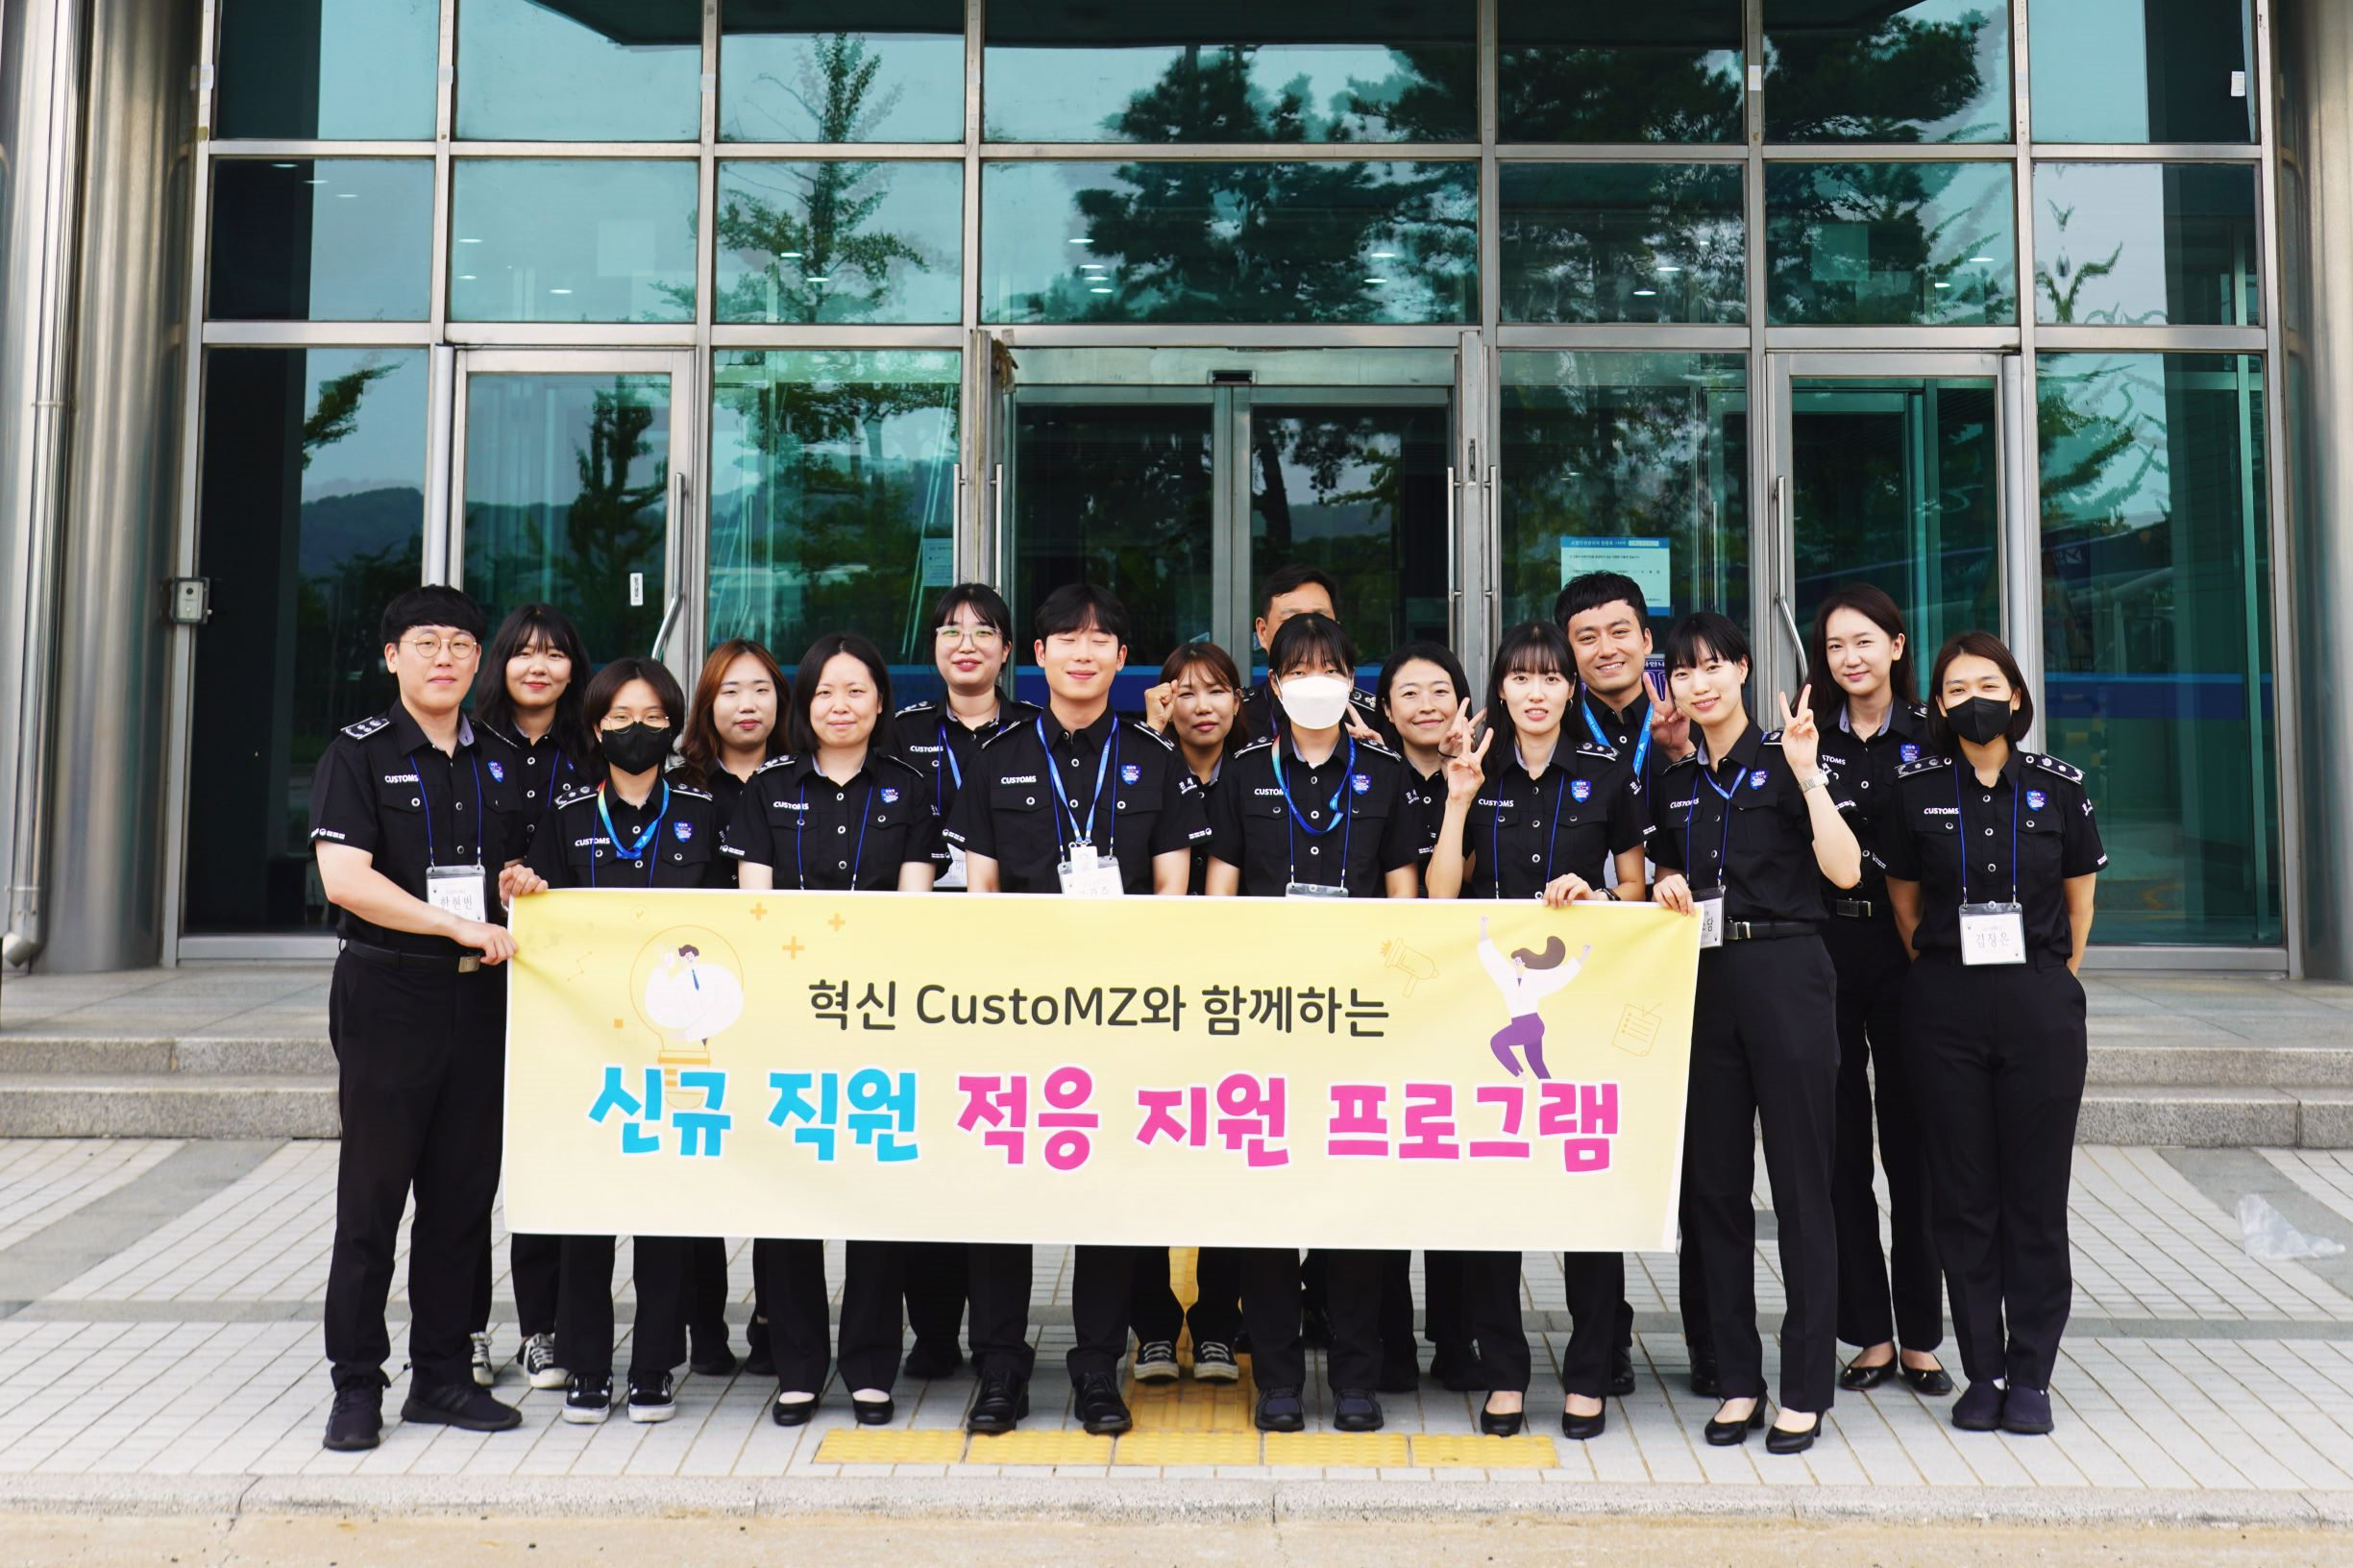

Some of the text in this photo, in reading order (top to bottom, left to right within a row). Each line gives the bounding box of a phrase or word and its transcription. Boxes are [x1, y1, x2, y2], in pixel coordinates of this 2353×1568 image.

[384, 774, 420, 784] CUSTOMS
[1000, 775, 1038, 785] CUSTOMS
[1254, 788, 1285, 796] CUSTOM
[1478, 798, 1514, 808] CUSTOMS
[575, 837, 611, 846] CUSTOMS
[808, 979, 1389, 1038] 혁신 CustoMZ와 함께하는
[588, 1066, 1618, 1173] 신규 직원 적응 지원 프로그램
